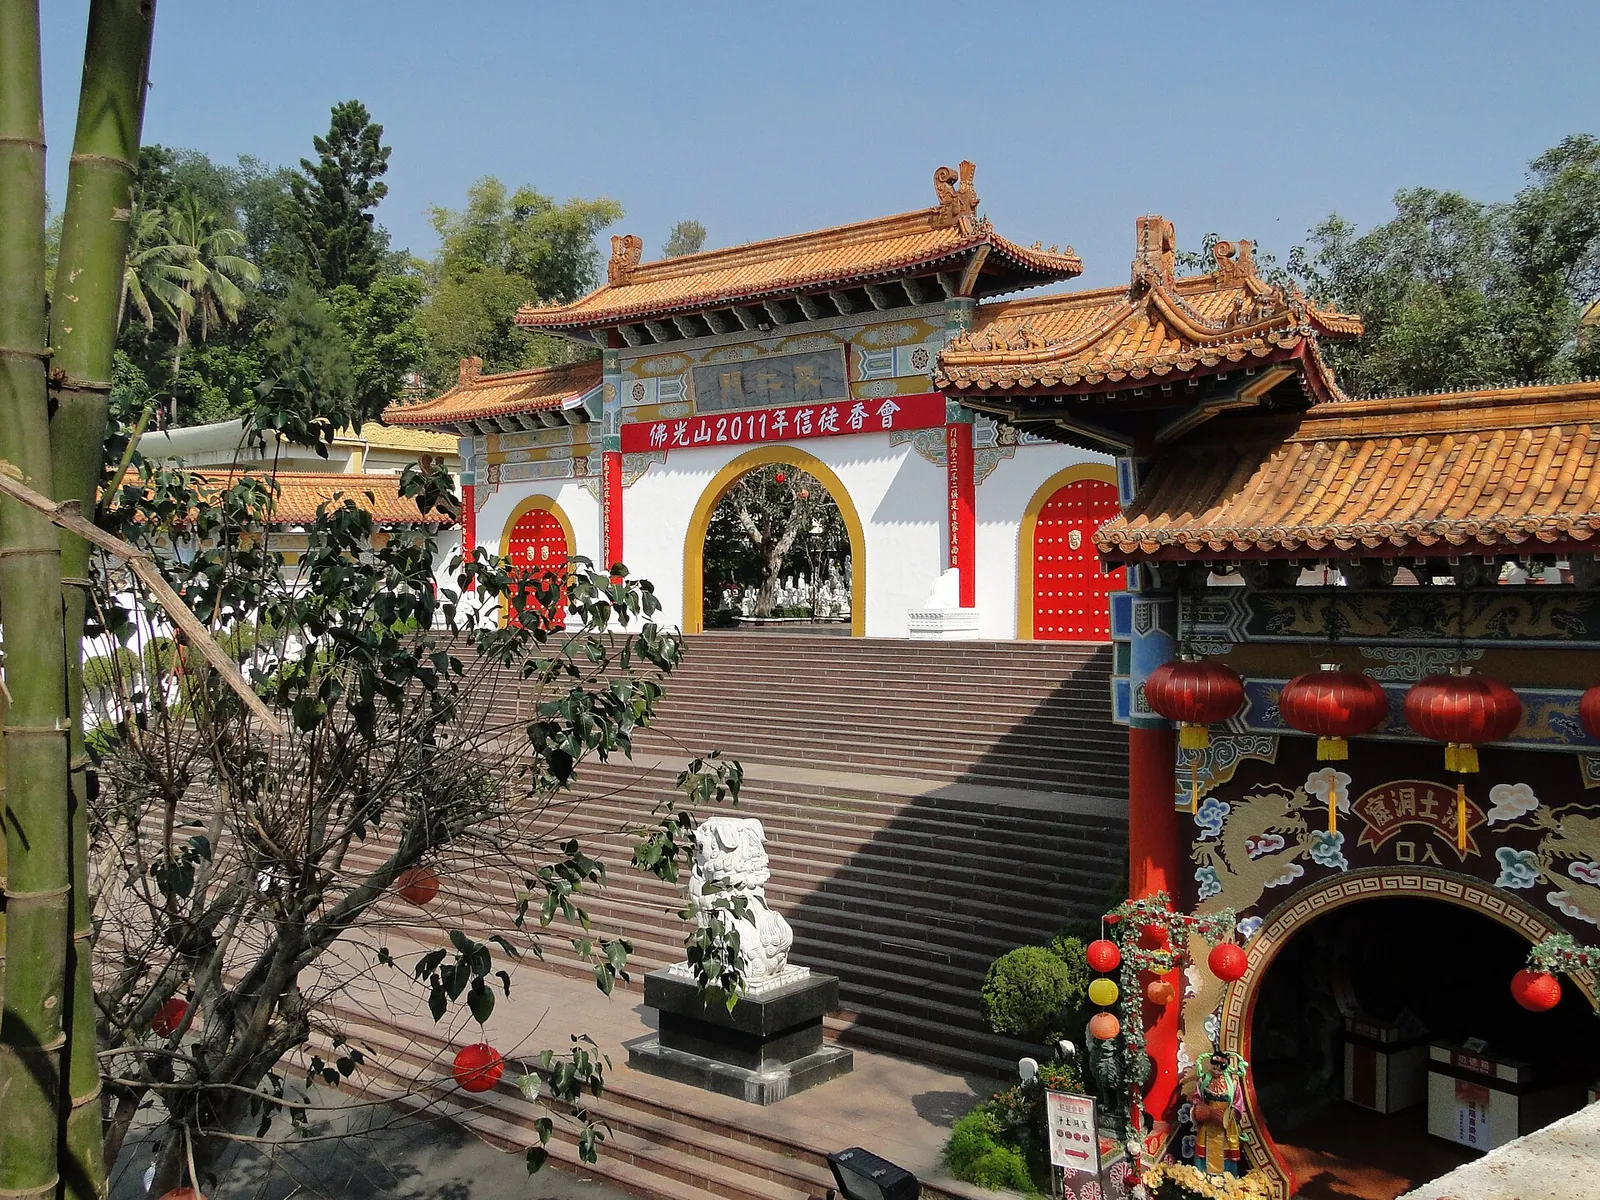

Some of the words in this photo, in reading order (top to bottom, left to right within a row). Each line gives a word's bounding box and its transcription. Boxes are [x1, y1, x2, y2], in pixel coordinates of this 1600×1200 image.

[649, 399, 901, 449] 佛光山2011年信徒香會
[1395, 841, 1443, 865] 入口
